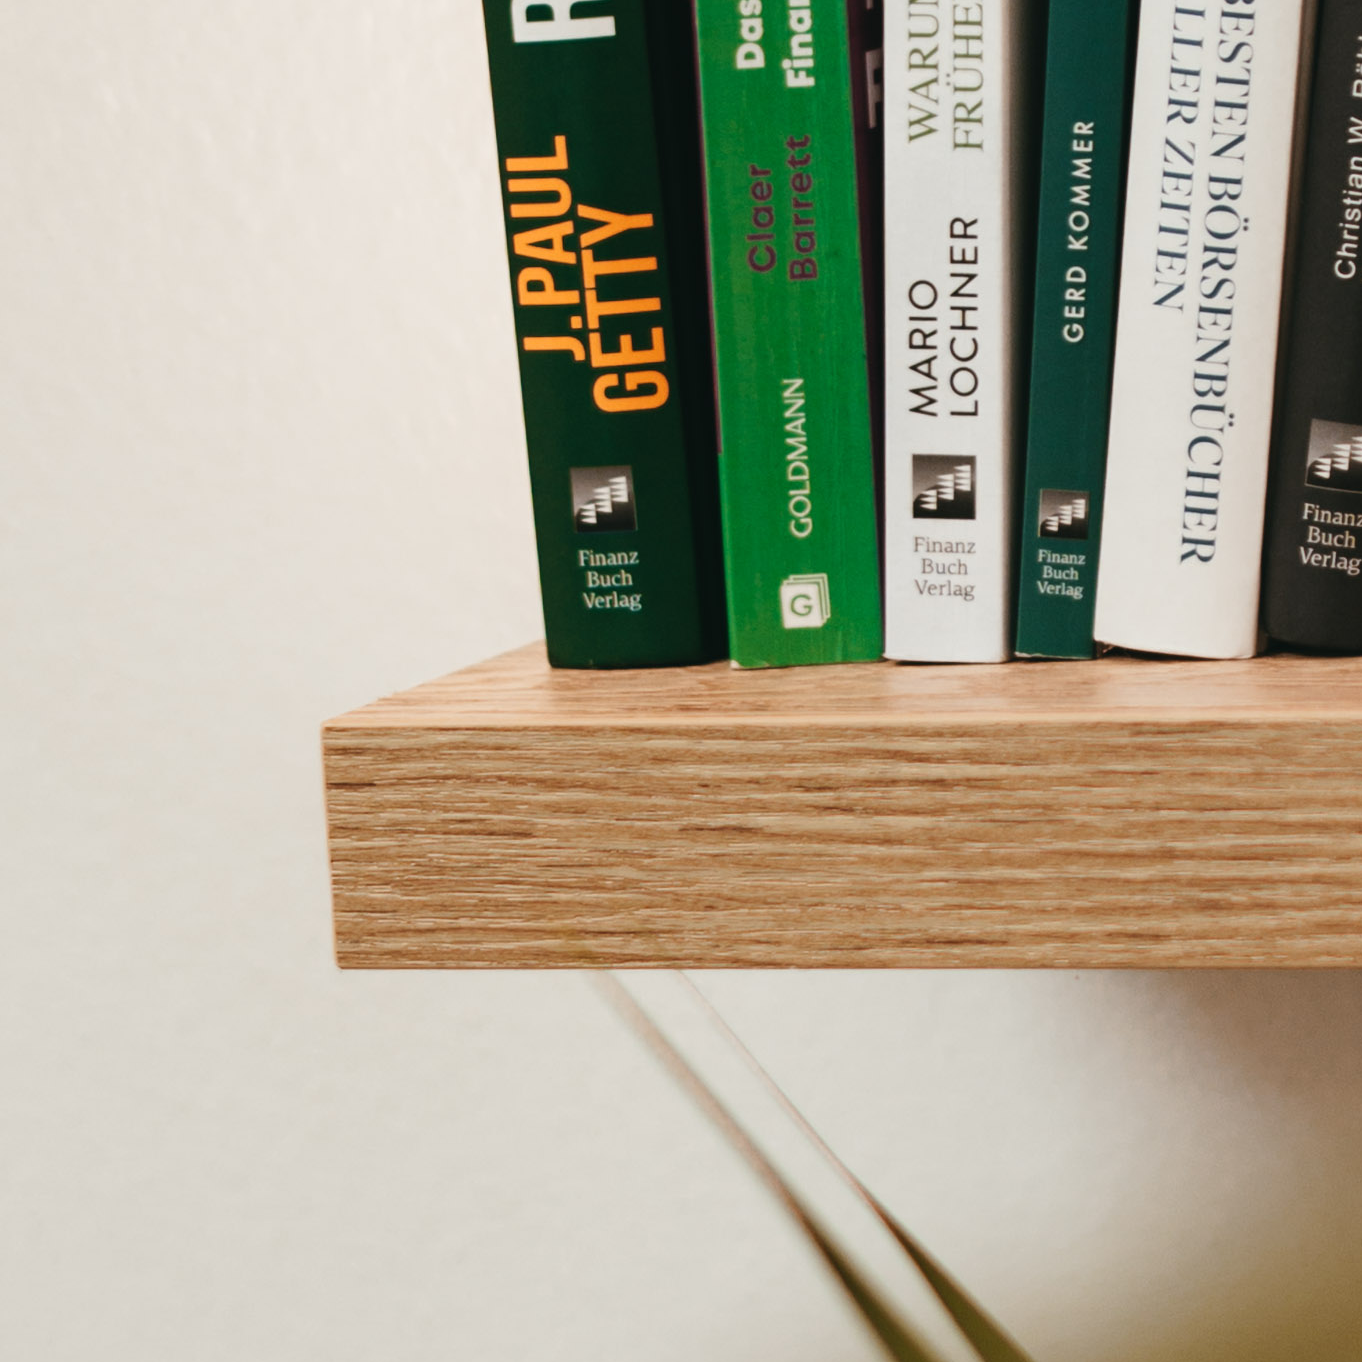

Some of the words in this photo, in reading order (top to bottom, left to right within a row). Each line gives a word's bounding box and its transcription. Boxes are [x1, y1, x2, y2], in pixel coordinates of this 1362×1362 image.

[736, 1, 765, 69] Das
[786, 135, 817, 280] Barrett
[1068, 122, 1094, 250] KOMMER
[747, 165, 776, 273] Claer
[1153, 140, 1195, 310] ZEITEN
[577, 204, 669, 412] GETTY
[950, 218, 978, 416] LOCHNER
[1063, 266, 1086, 342] GERD
[909, 280, 937, 416] MARIO
[1178, 173, 1251, 563] BÖRSENBÜCHER
[783, 379, 812, 538] GOLDMANN
[579, 550, 639, 566] Finanz
[914, 537, 975, 554] Finanz
[1038, 549, 1085, 567] Finanz
[1300, 546, 1361, 575] Verlag
[1307, 526, 1355, 551] Buch
[587, 570, 632, 588] Buch
[915, 580, 974, 601] Verlag
[922, 558, 968, 575] Buch
[1037, 581, 1083, 599] Verlag
[1043, 567, 1078, 580] Buch
[583, 591, 642, 611] Verlag
